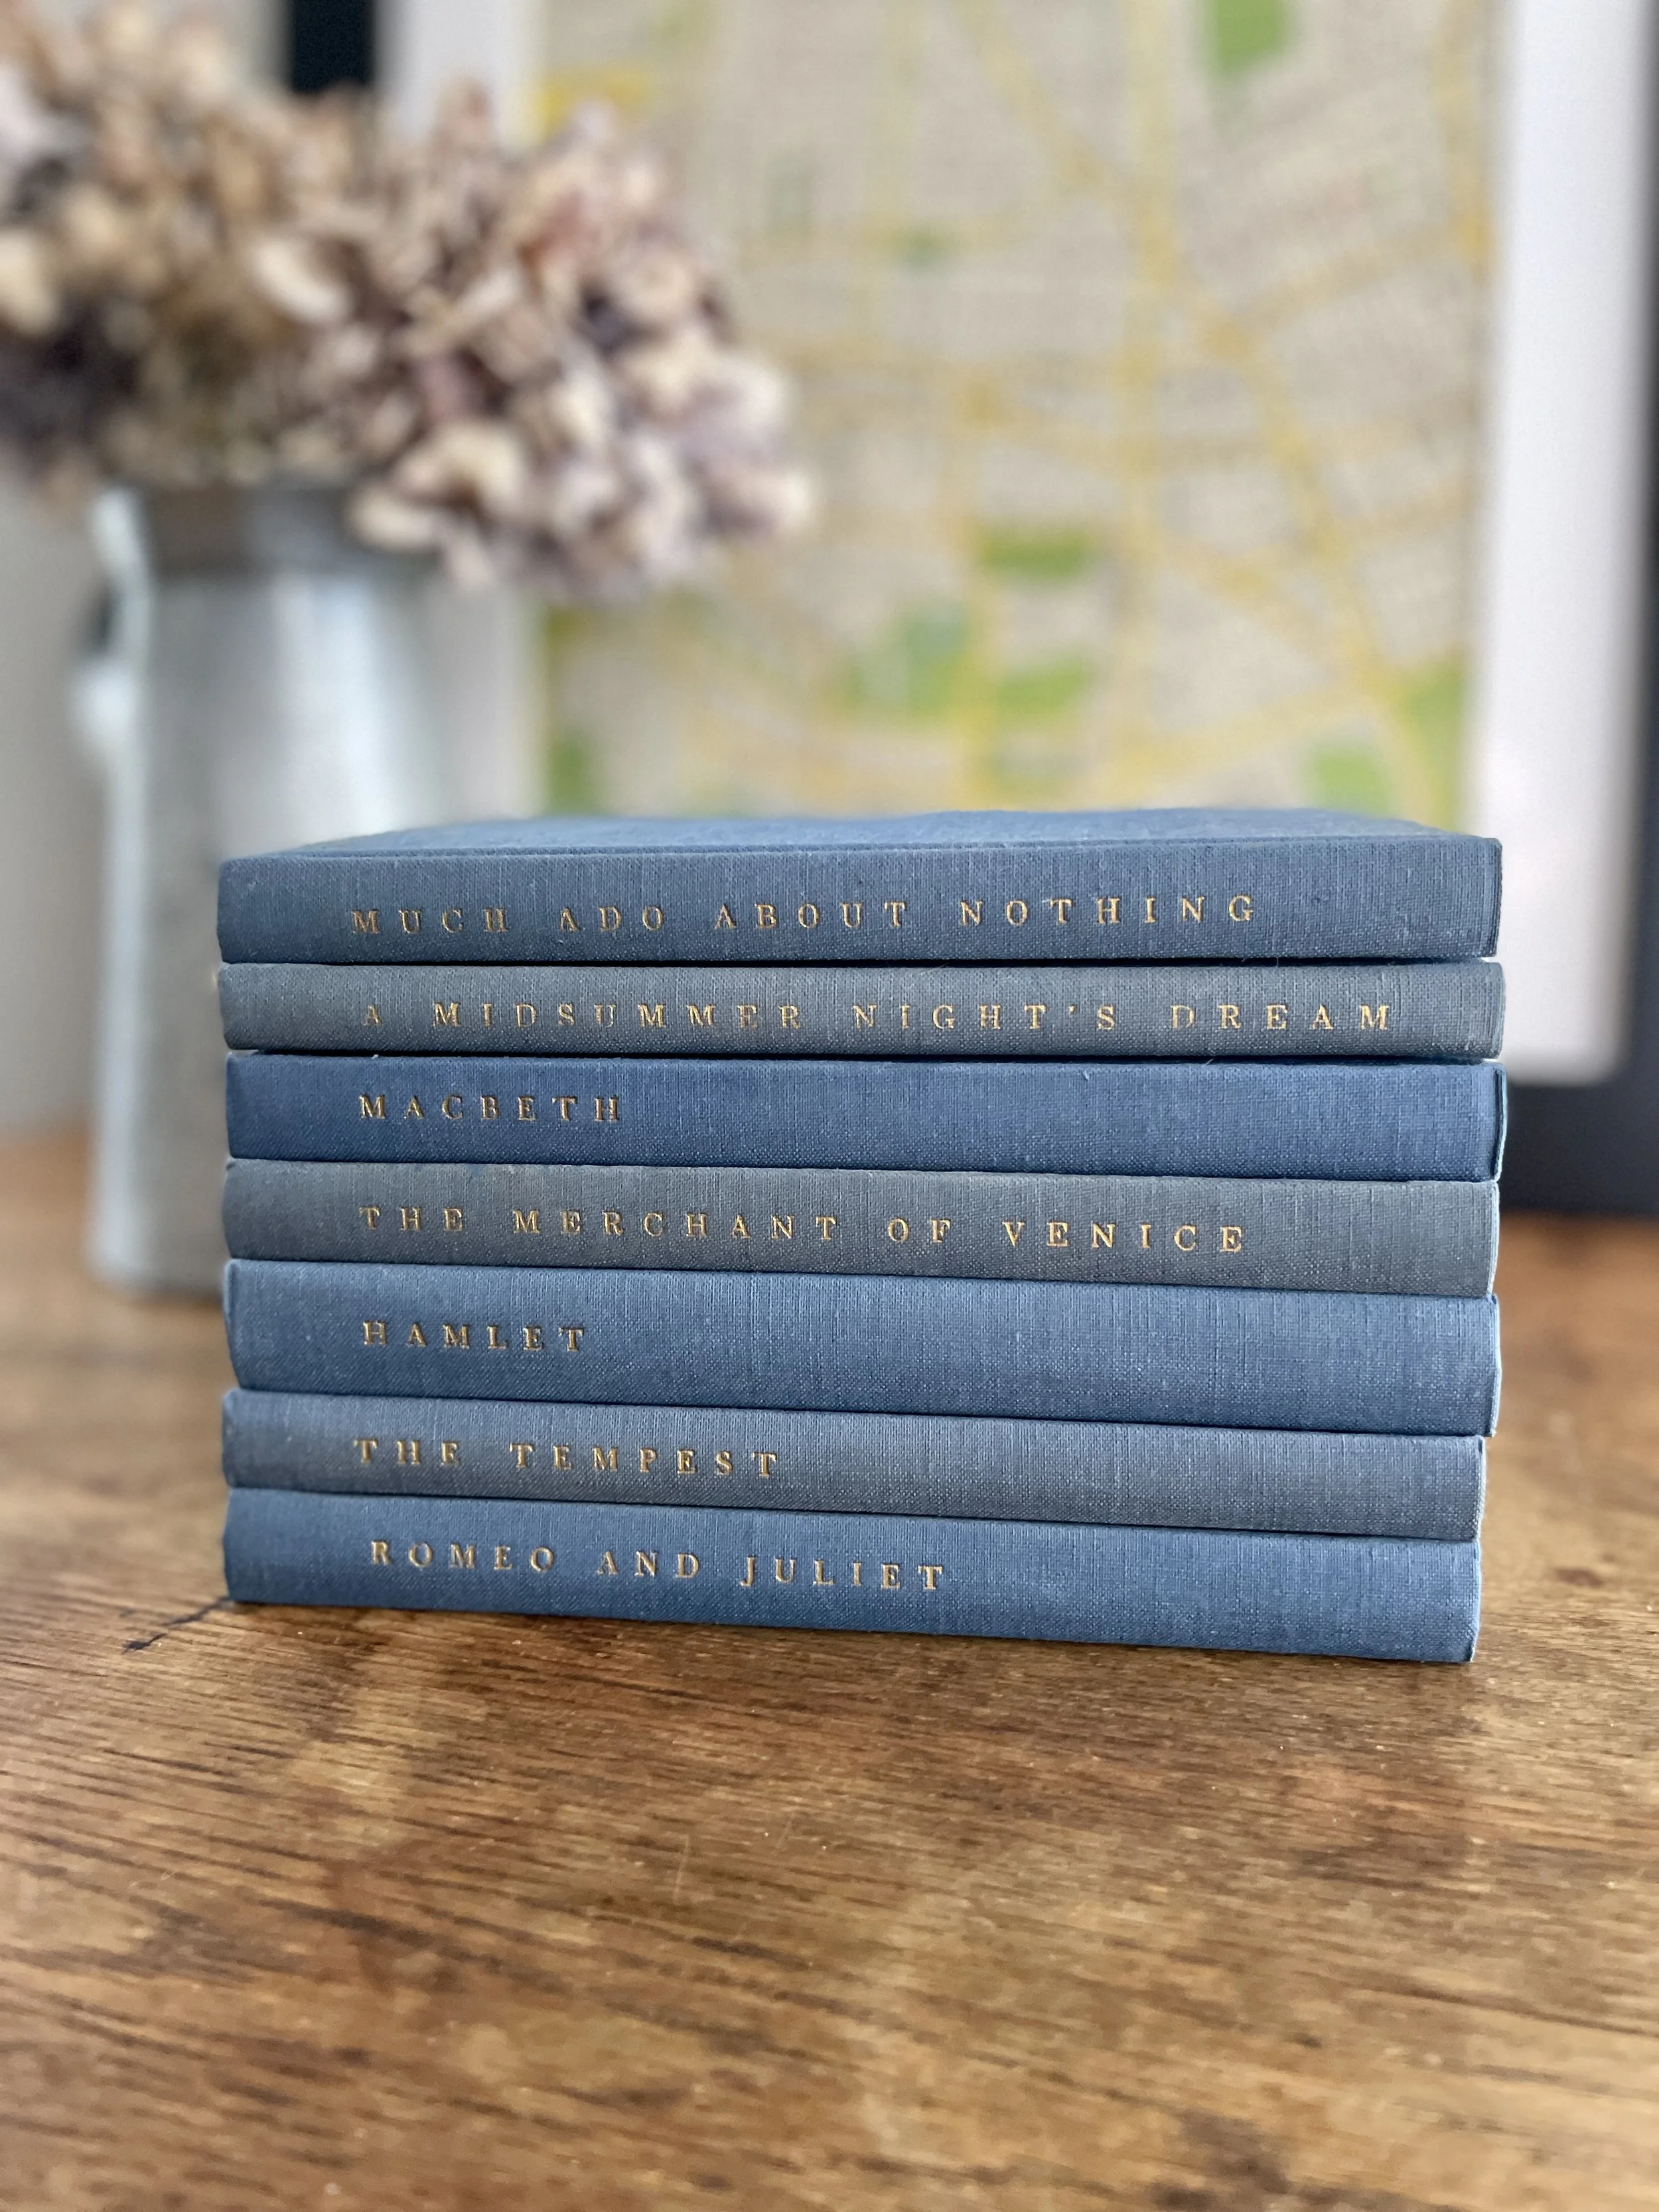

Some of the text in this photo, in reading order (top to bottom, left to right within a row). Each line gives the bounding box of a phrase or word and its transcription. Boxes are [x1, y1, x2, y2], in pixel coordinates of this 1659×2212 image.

[352, 895, 1254, 934] MUCH ADO ABOUT NOTHING
[363, 1001, 1391, 1031] A MIDSUMMER NIGHT'S DREAM
[359, 1094, 620, 1122] MACBETH
[359, 1206, 1246, 1253] THE MERCHANT OF VENICE
[362, 1321, 586, 1353] HAMLET
[353, 1439, 778, 1478] THE TEMPEST
[370, 1540, 944, 1590] ROMEO AND JULIET
